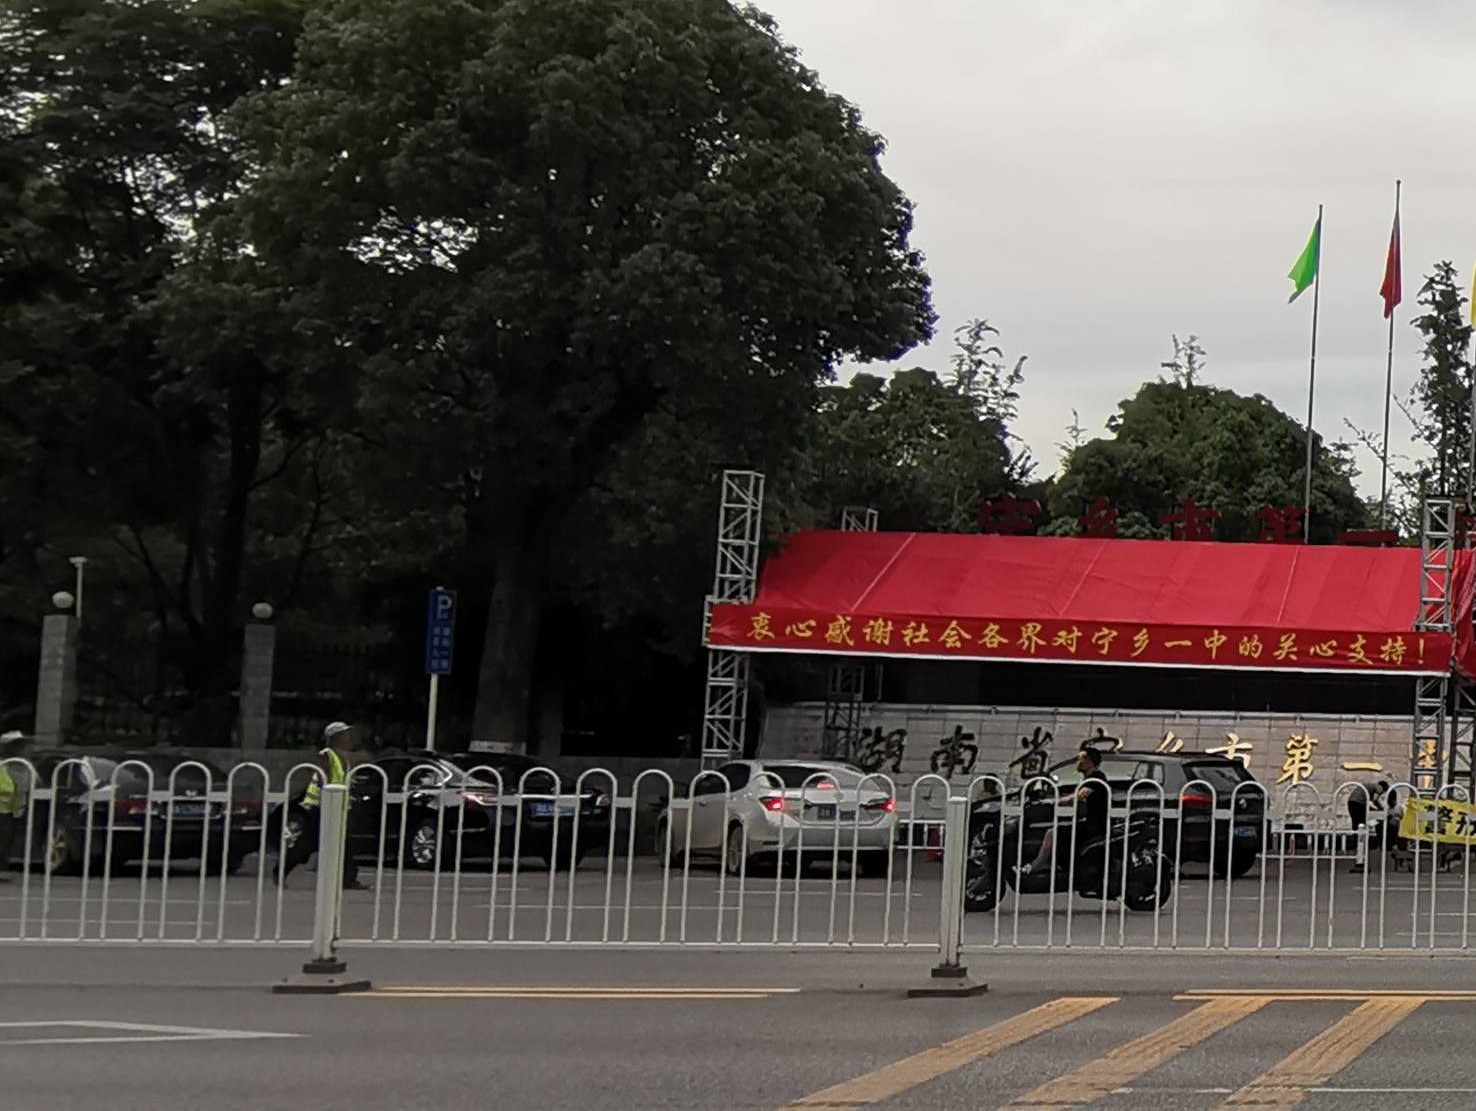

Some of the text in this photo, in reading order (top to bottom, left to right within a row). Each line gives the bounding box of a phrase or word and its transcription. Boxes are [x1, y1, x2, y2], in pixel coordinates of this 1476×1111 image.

[746, 612, 1426, 666] 衷心感谢社会各界对宁乡一中的关心支持！
